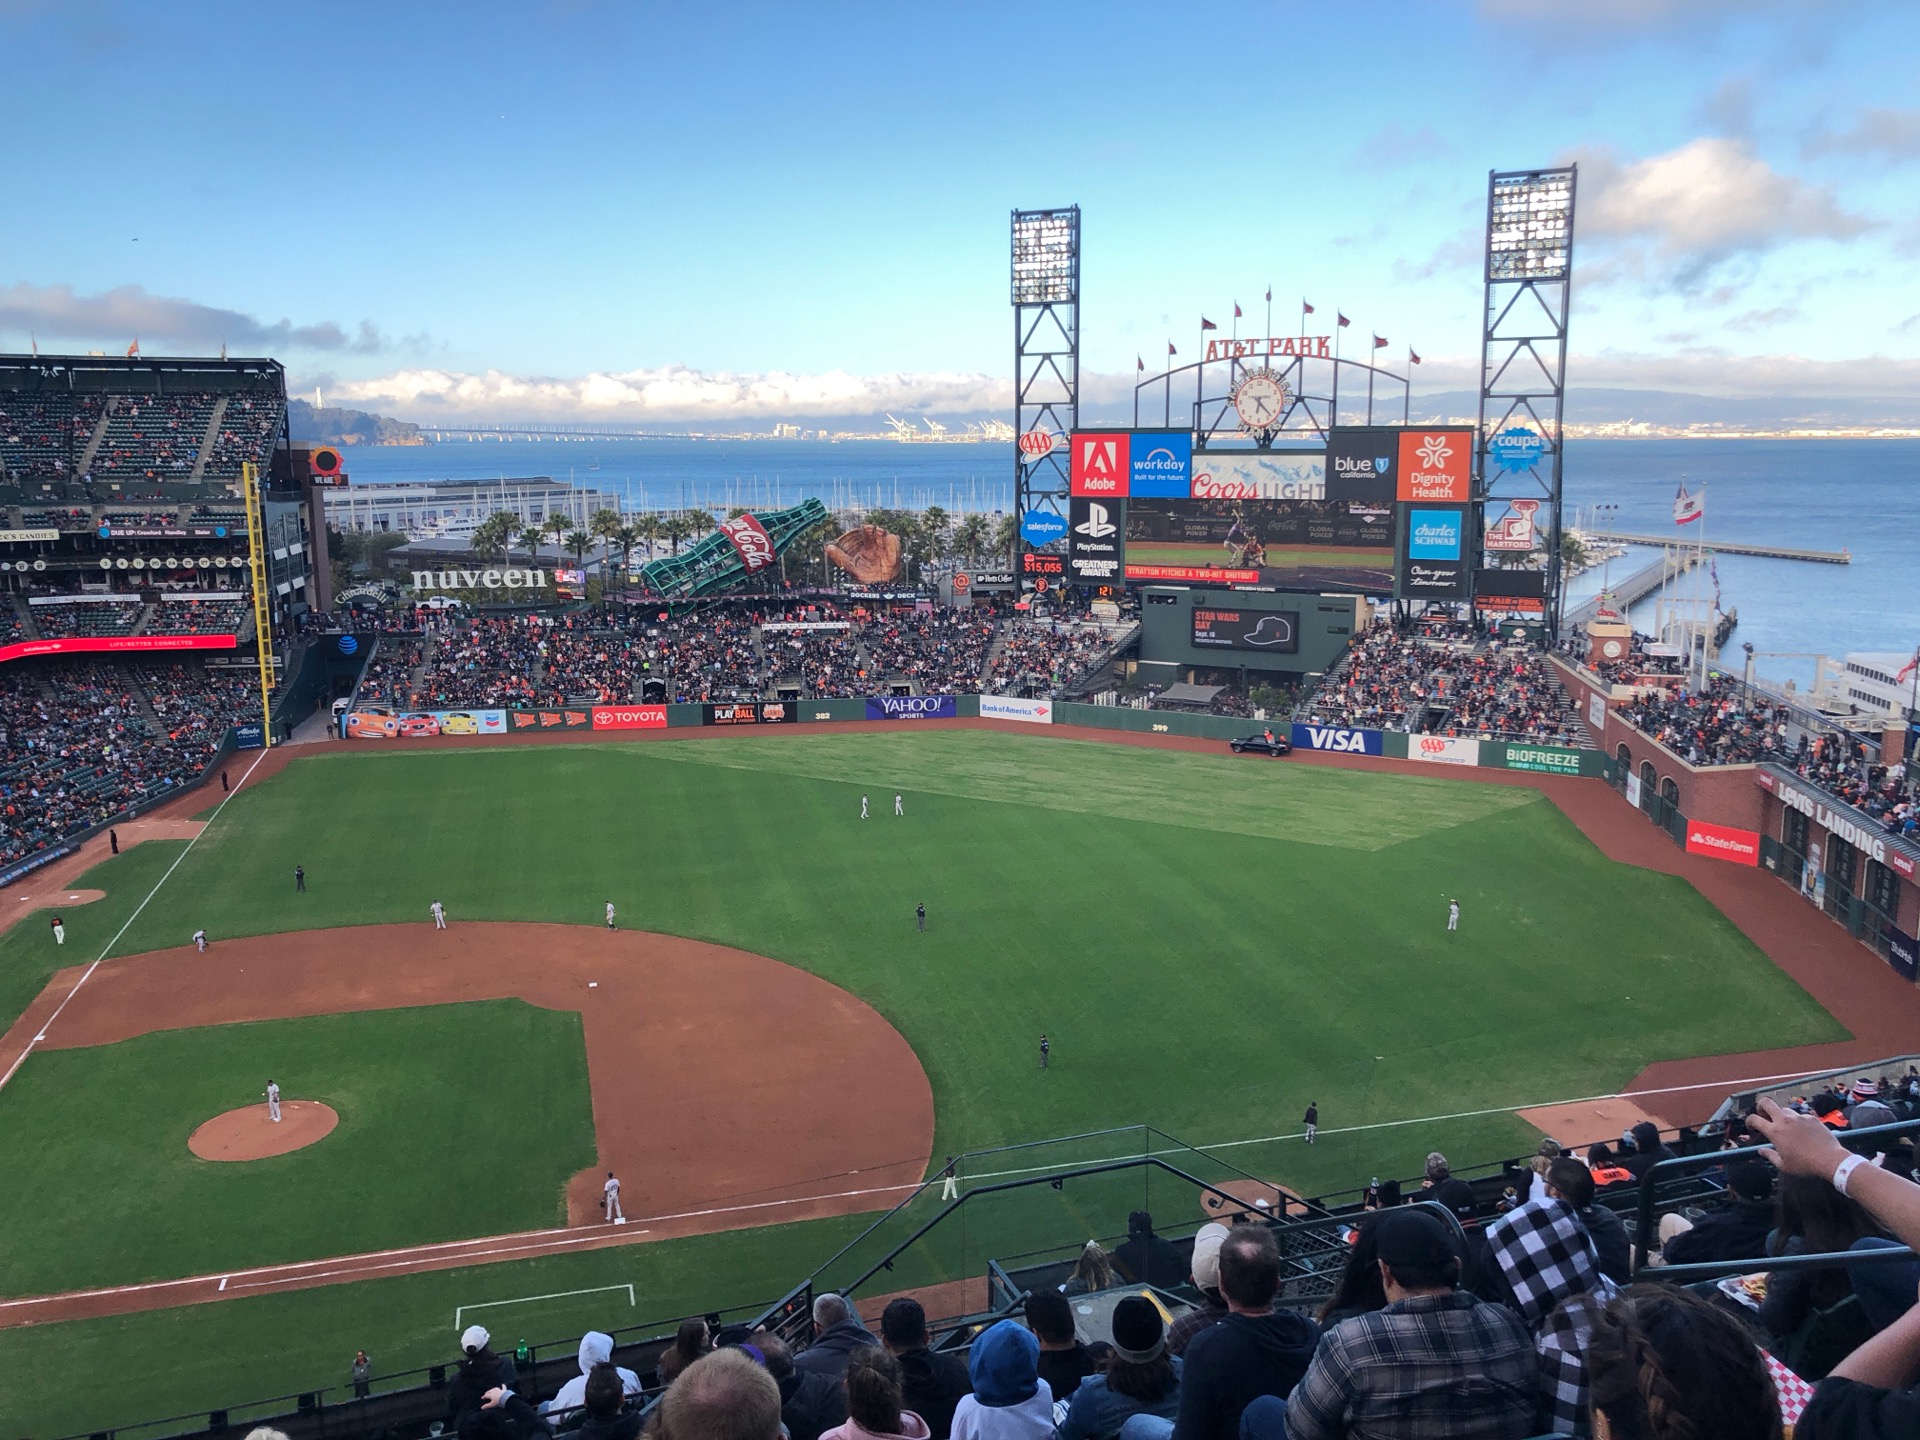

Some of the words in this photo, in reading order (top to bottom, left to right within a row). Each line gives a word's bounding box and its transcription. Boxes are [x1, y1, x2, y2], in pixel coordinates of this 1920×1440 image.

[1206, 339, 1260, 363] AT&T
[1269, 336, 1331, 360] PARK
[1227, 379, 1241, 407] SAN
[1237, 419, 1282, 440] GIANTS
[1022, 433, 1051, 453] AAA
[1497, 436, 1540, 449] coupa
[1134, 459, 1185, 472] workday
[1335, 456, 1372, 471] blue
[314, 476, 324, 484] WE
[1340, 471, 1376, 479] california
[1410, 472, 1455, 487] Dignity
[1084, 477, 1116, 490] Adobe
[1191, 473, 1259, 499] Coors
[1263, 483, 1326, 499] LIGHT
[1412, 487, 1454, 498] Health
[1027, 522, 1063, 533] salesforce
[1415, 524, 1455, 536] charles
[19, 532, 55, 540] CANDIES
[1415, 537, 1456, 546] SCHWAB
[1487, 541, 1532, 549] HARTFORD
[1024, 562, 1062, 574] $15,055
[1072, 560, 1119, 570] GREATNESS
[411, 569, 547, 591] nuveen
[1128, 568, 1159, 576] STRATTON
[1161, 569, 1186, 577] PITCHES
[1195, 570, 1222, 578] TWO-HIT
[1225, 571, 1253, 580] SHUTOUT
[335, 588, 390, 604] Ghirardelli
[1195, 611, 1215, 621] STAR
[1217, 612, 1240, 622] WARS
[1195, 621, 1211, 630] DAY
[881, 697, 942, 714] YAHOO!
[982, 704, 998, 712] Bank
[1005, 707, 1032, 716] America
[614, 711, 666, 723] TOYOTA
[715, 710, 734, 719] PLAY
[735, 709, 755, 719] BALL
[1152, 724, 1168, 732] 399
[1305, 727, 1366, 753] VISA
[1423, 739, 1443, 752] AAA
[1432, 755, 1466, 764] Insurance
[1530, 763, 1547, 771] COOL
[1563, 767, 1579, 775] PAIN
[1816, 804, 1885, 864] LANDING
[1601, 1170, 1623, 1180] GIANTS
